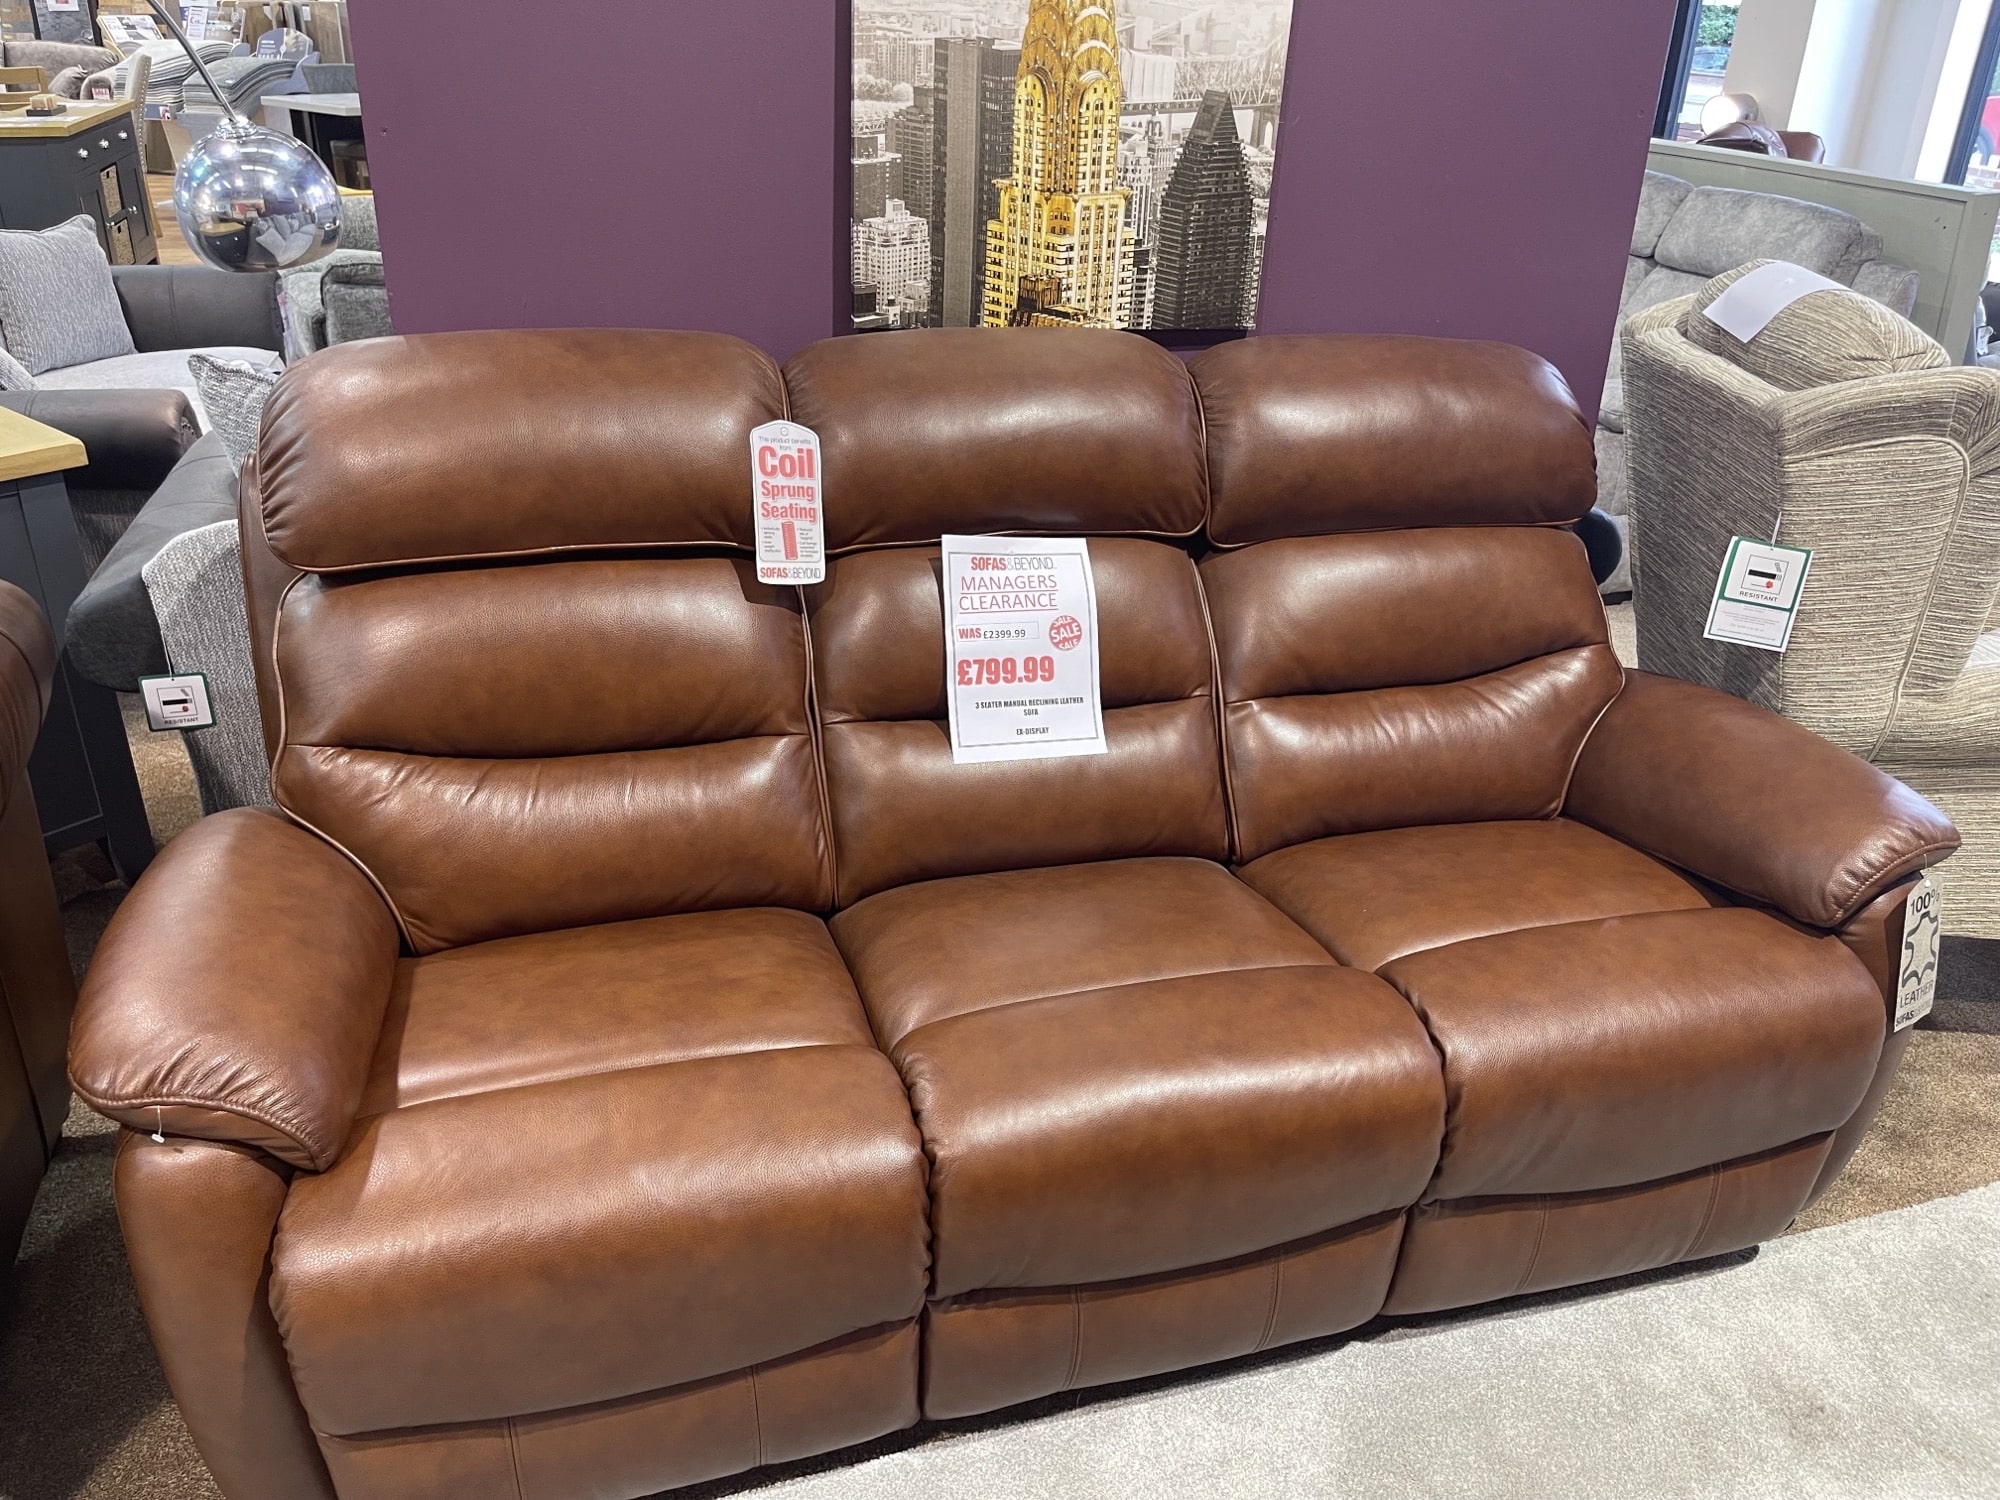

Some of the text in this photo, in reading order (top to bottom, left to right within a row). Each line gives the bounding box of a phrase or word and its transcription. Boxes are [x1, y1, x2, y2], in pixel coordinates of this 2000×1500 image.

[758, 446, 815, 478] Coil
[761, 480, 814, 502] Sprung
[761, 502, 816, 522] Seating
[961, 574, 1057, 591] MANAGERS
[959, 593, 1057, 610] CLEARANCE
[1740, 591, 1778, 602] RESISTANT
[1053, 616, 1072, 627] SALE
[959, 628, 1026, 639] WAS £2399.99
[1051, 622, 1081, 642] SALE
[1058, 638, 1078, 649] SALE
[957, 655, 1055, 686] £799.99
[981, 701, 1002, 709] SEATER
[1004, 700, 1027, 708] MANUAL
[1029, 698, 1059, 706] RECLINING
[1016, 727, 1049, 735] EX-DISPLAY
[1899, 979, 1934, 1009] LEATHER
